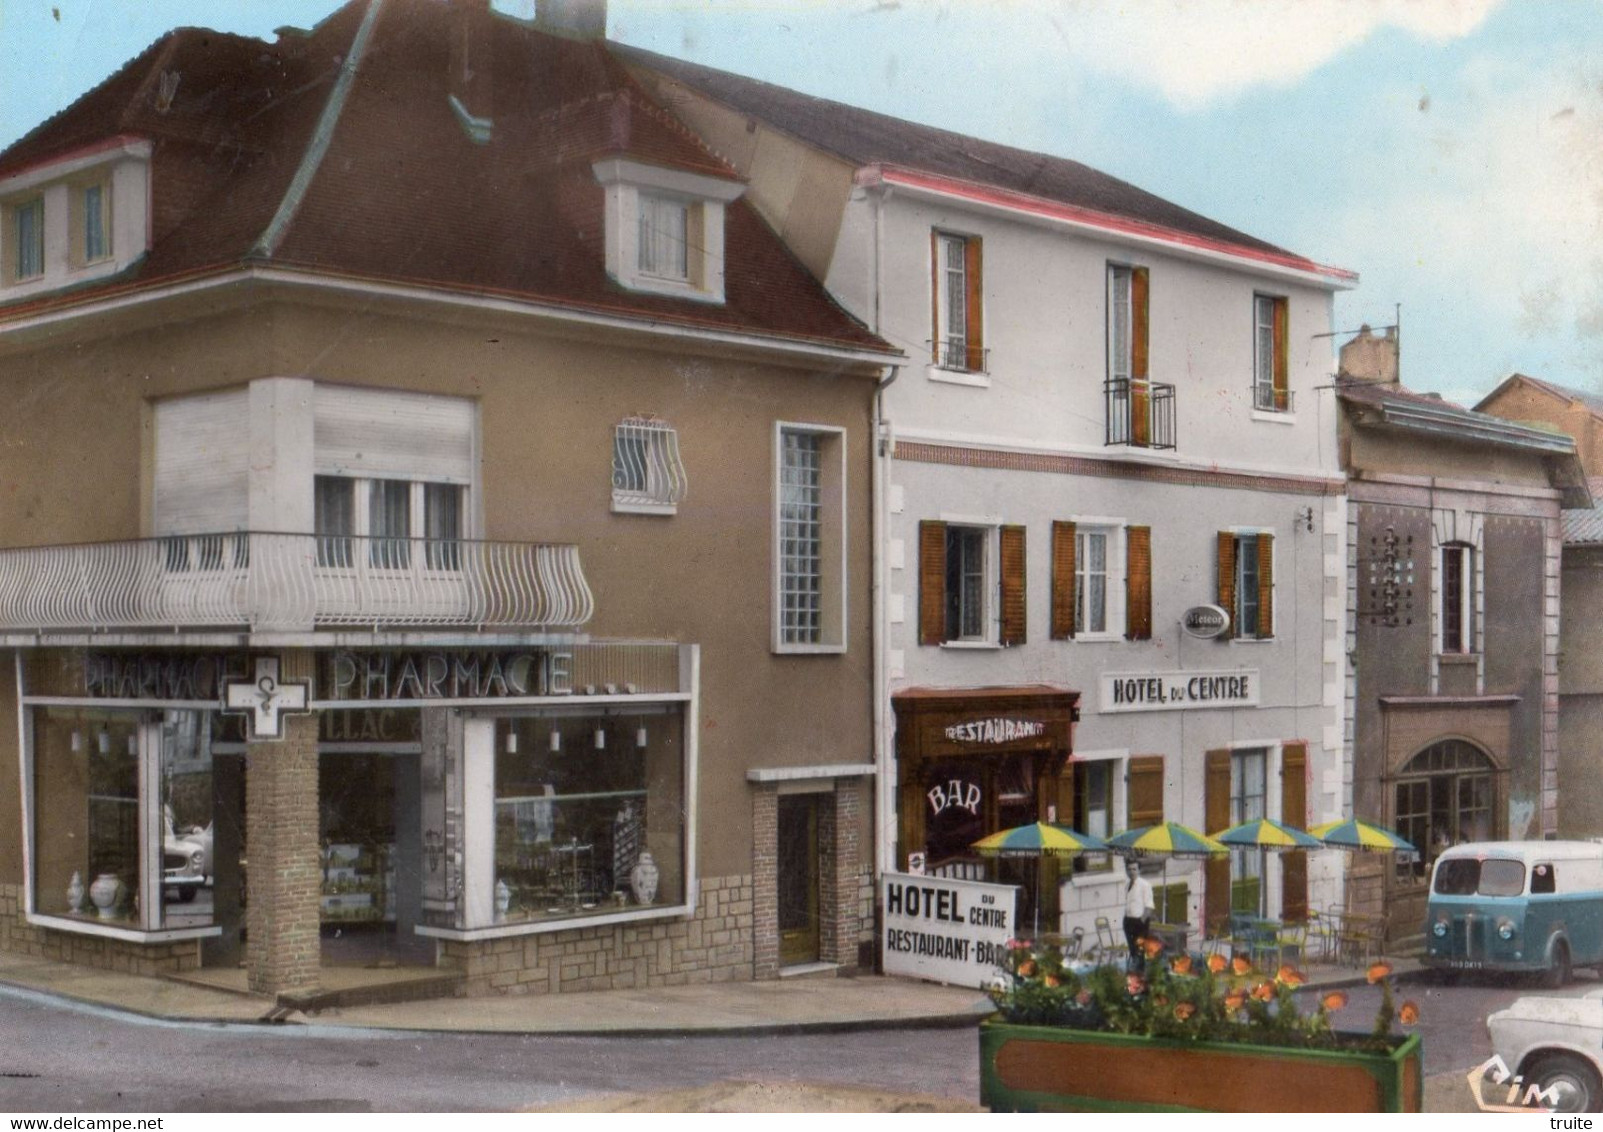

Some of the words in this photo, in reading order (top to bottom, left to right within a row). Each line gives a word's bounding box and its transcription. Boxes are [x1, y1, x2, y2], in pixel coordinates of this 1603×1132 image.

[333, 652, 573, 699] PHARMACIE
[1113, 678, 1167, 704] HOTEL
[1171, 686, 1186, 701] DU
[1188, 675, 1249, 700] CENTRE
[945, 718, 1044, 744] RESTAURANT
[927, 780, 981, 815] BAR
[888, 883, 965, 923] HOTEL
[981, 894, 995, 905] DU
[969, 906, 1007, 929] CENTRE
